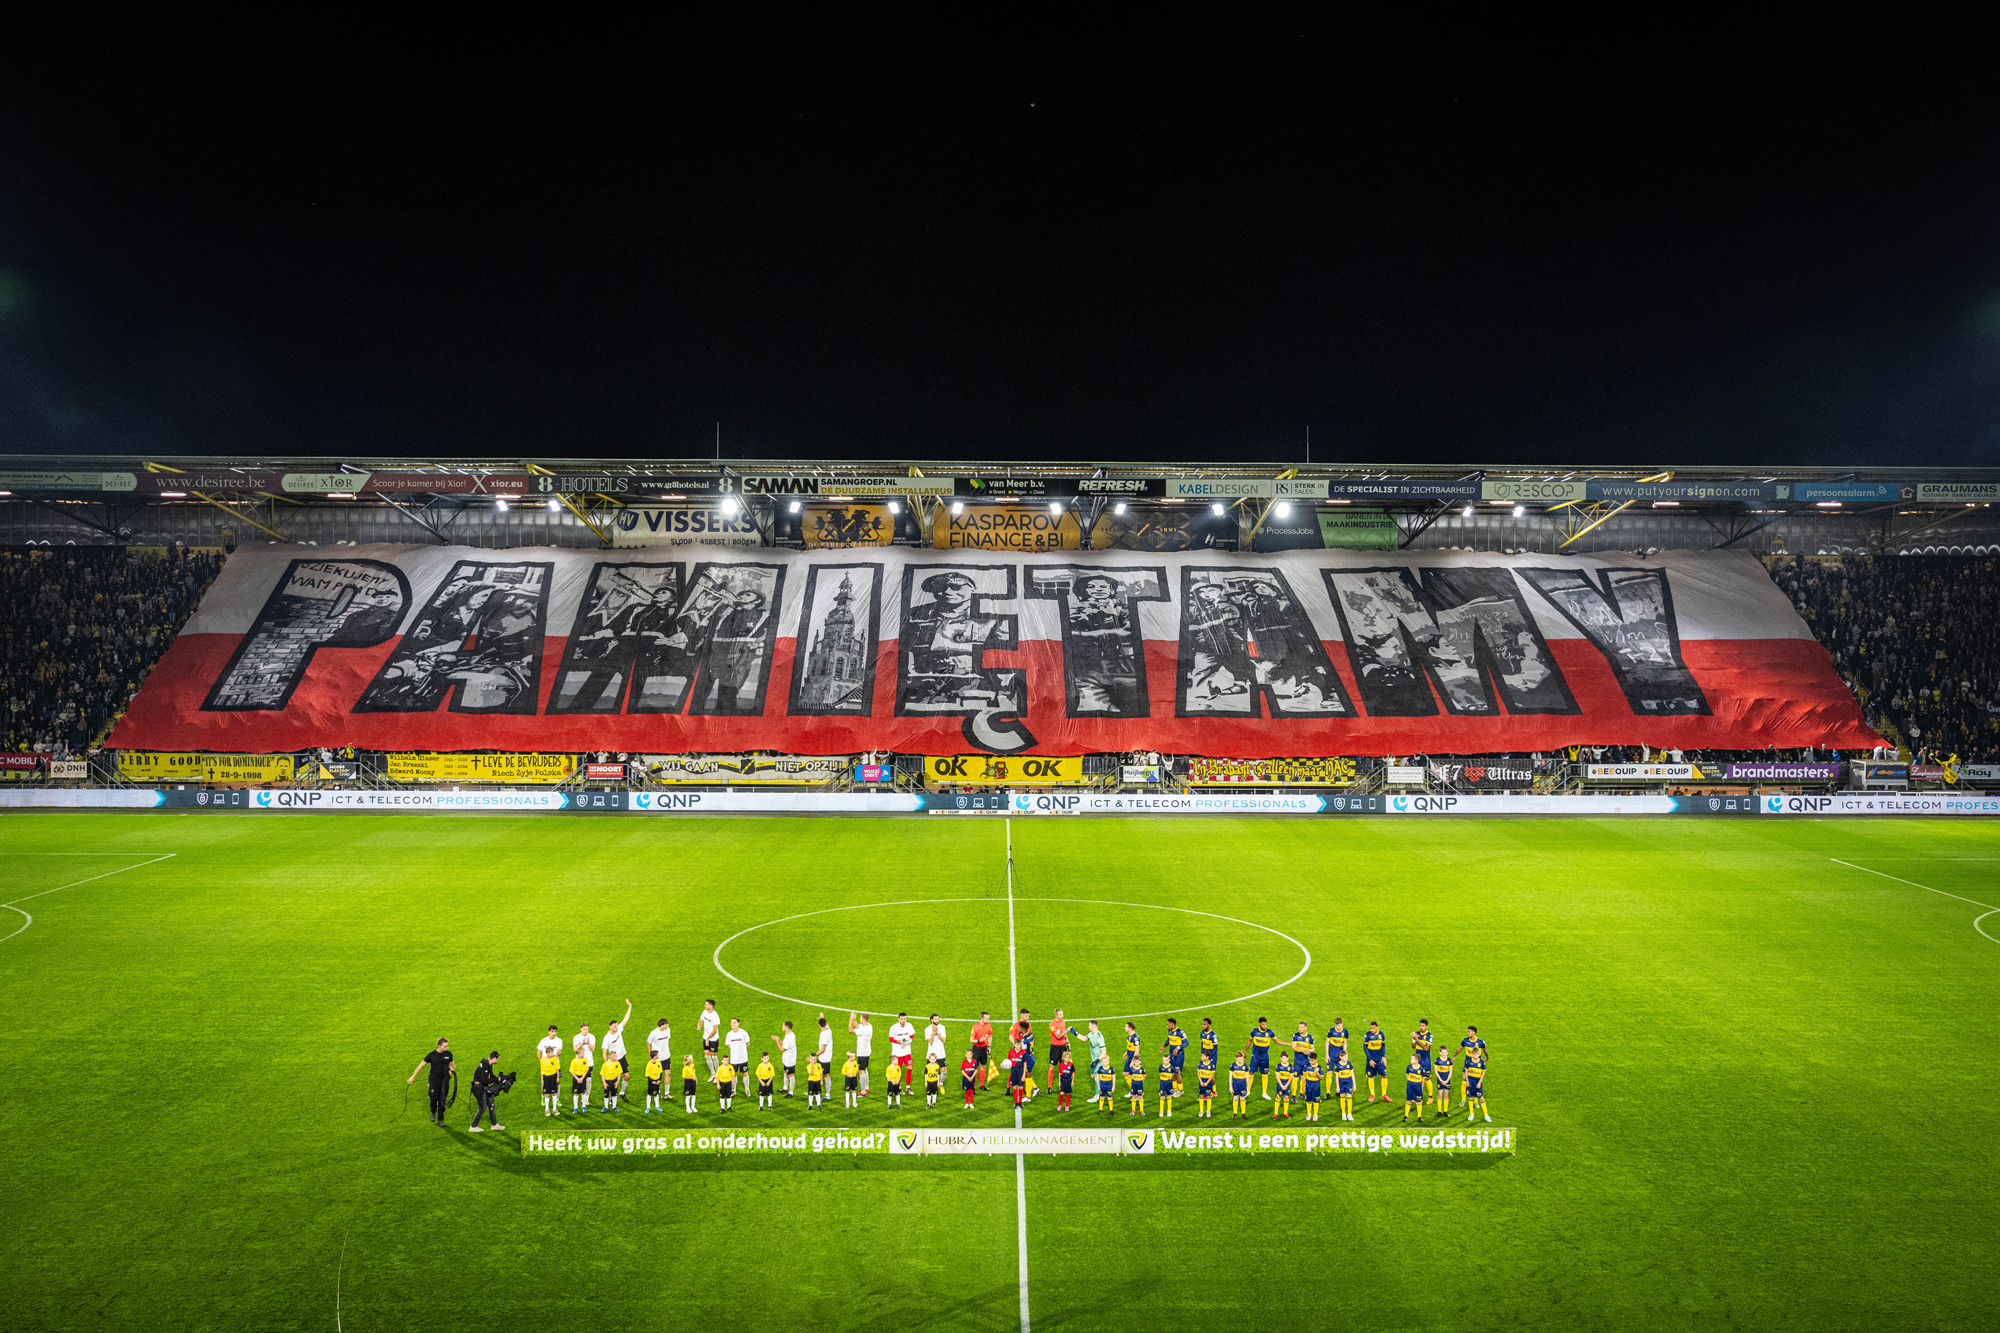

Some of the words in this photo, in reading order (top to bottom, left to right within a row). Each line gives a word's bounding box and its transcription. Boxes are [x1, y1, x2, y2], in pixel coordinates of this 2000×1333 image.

[156, 475, 265, 488] www.desiree.be
[320, 476, 354, 488] XIOR
[373, 479, 394, 488] Scoor
[397, 479, 406, 490] je
[407, 479, 433, 488] kamer
[435, 479, 446, 490] bij
[447, 479, 467, 488] Xior!
[490, 480, 523, 488] xior.eu
[560, 477, 629, 493] HOTELS
[641, 480, 710, 490] www.gr8hotels.nl
[743, 477, 819, 494] SAMAN
[821, 478, 898, 486] SAMANGROEP.NL
[988, 480, 1005, 488] van
[1006, 479, 1029, 488] Meer
[1030, 479, 1045, 488] b.v.
[835, 486, 886, 494] DUURZAME
[888, 487, 953, 495] INSTALLATEUR
[1178, 484, 1259, 495] KABELDESIGN
[1334, 485, 1345, 493] DE
[1347, 485, 1398, 493] SPECIALIST
[1400, 485, 1410, 494] IN
[1411, 486, 1476, 494] ZICHTBAARHEID
[1514, 484, 1574, 497] RESCOP
[1602, 485, 1760, 499] www.putyoursignon.com
[1806, 488, 1875, 498] persoonsalarm
[1922, 484, 1998, 493] GRAUMANS
[643, 510, 757, 533] VISSERS
[949, 513, 1064, 531] KASPAROV
[1266, 526, 1314, 535] ProcessJobs
[670, 538, 693, 546] SLOOP
[699, 538, 726, 546] ASBEST
[732, 538, 757, 546] BODEM
[949, 532, 1033, 547] FINANCE
[1047, 532, 1064, 547] BI
[290, 575, 331, 590] WAM
[7, 757, 49, 765] MOBILIY
[120, 755, 160, 766] FERRY
[169, 755, 201, 766] GOOD
[218, 756, 233, 767] FOR
[482, 756, 503, 768] LEVE
[505, 756, 515, 768] DE
[517, 756, 561, 768] BEVRIJDERS
[66, 764, 86, 772] DNH
[659, 760, 681, 773] WIJ
[685, 761, 719, 773] GAAN
[775, 760, 801, 772] NIET
[934, 758, 968, 777] OK
[1022, 760, 1063, 777] OK
[1206, 758, 1251, 781] Brabant
[1252, 760, 1264, 776] is
[1265, 759, 1295, 780] alleen
[1296, 766, 1322, 778] maar
[1597, 767, 1637, 775] BEEQUIP
[1650, 767, 1689, 775] BEEQUIP
[220, 771, 262, 779] 28-9-1998
[491, 769, 515, 777] Niech
[535, 769, 562, 777] Polska
[1124, 768, 1155, 777] Huijbregts
[1487, 766, 1533, 781] Ultras
[1968, 769, 1992, 778] Roy
[278, 792, 321, 807] QNP
[331, 795, 353, 805] ICT
[357, 795, 364, 805] &
[369, 795, 432, 805] TELECOM
[437, 795, 549, 805] PROFESSIONALS
[657, 794, 701, 808] QNP
[1036, 796, 1081, 810] QNP
[1090, 799, 1112, 808] ICT
[1115, 799, 1124, 808] &
[1128, 799, 1191, 808] TELECOM
[1195, 799, 1307, 808] PROFESSIONALS
[1414, 797, 1458, 812] QNP
[1788, 798, 1832, 812] QNP
[1841, 801, 1862, 810] ICT
[1866, 801, 1874, 810] &
[1879, 801, 1942, 810] TELECOM
[529, 1134, 582, 1151] Heeft
[587, 1137, 617, 1151] uw
[622, 1137, 667, 1153] gras
[673, 1133, 692, 1150] al
[698, 1133, 806, 1150] onderhoud
[812, 1132, 885, 1153] gehad?
[927, 1135, 978, 1146] HUBRA
[982, 1135, 1117, 1146] FIELDMANAGEMENT
[1162, 1131, 1234, 1149] Wenst
[1238, 1135, 1252, 1149] u
[1258, 1135, 1299, 1149] een
[1305, 1131, 1392, 1152] prettige
[1399, 1130, 1511, 1152] wedstrijd!
